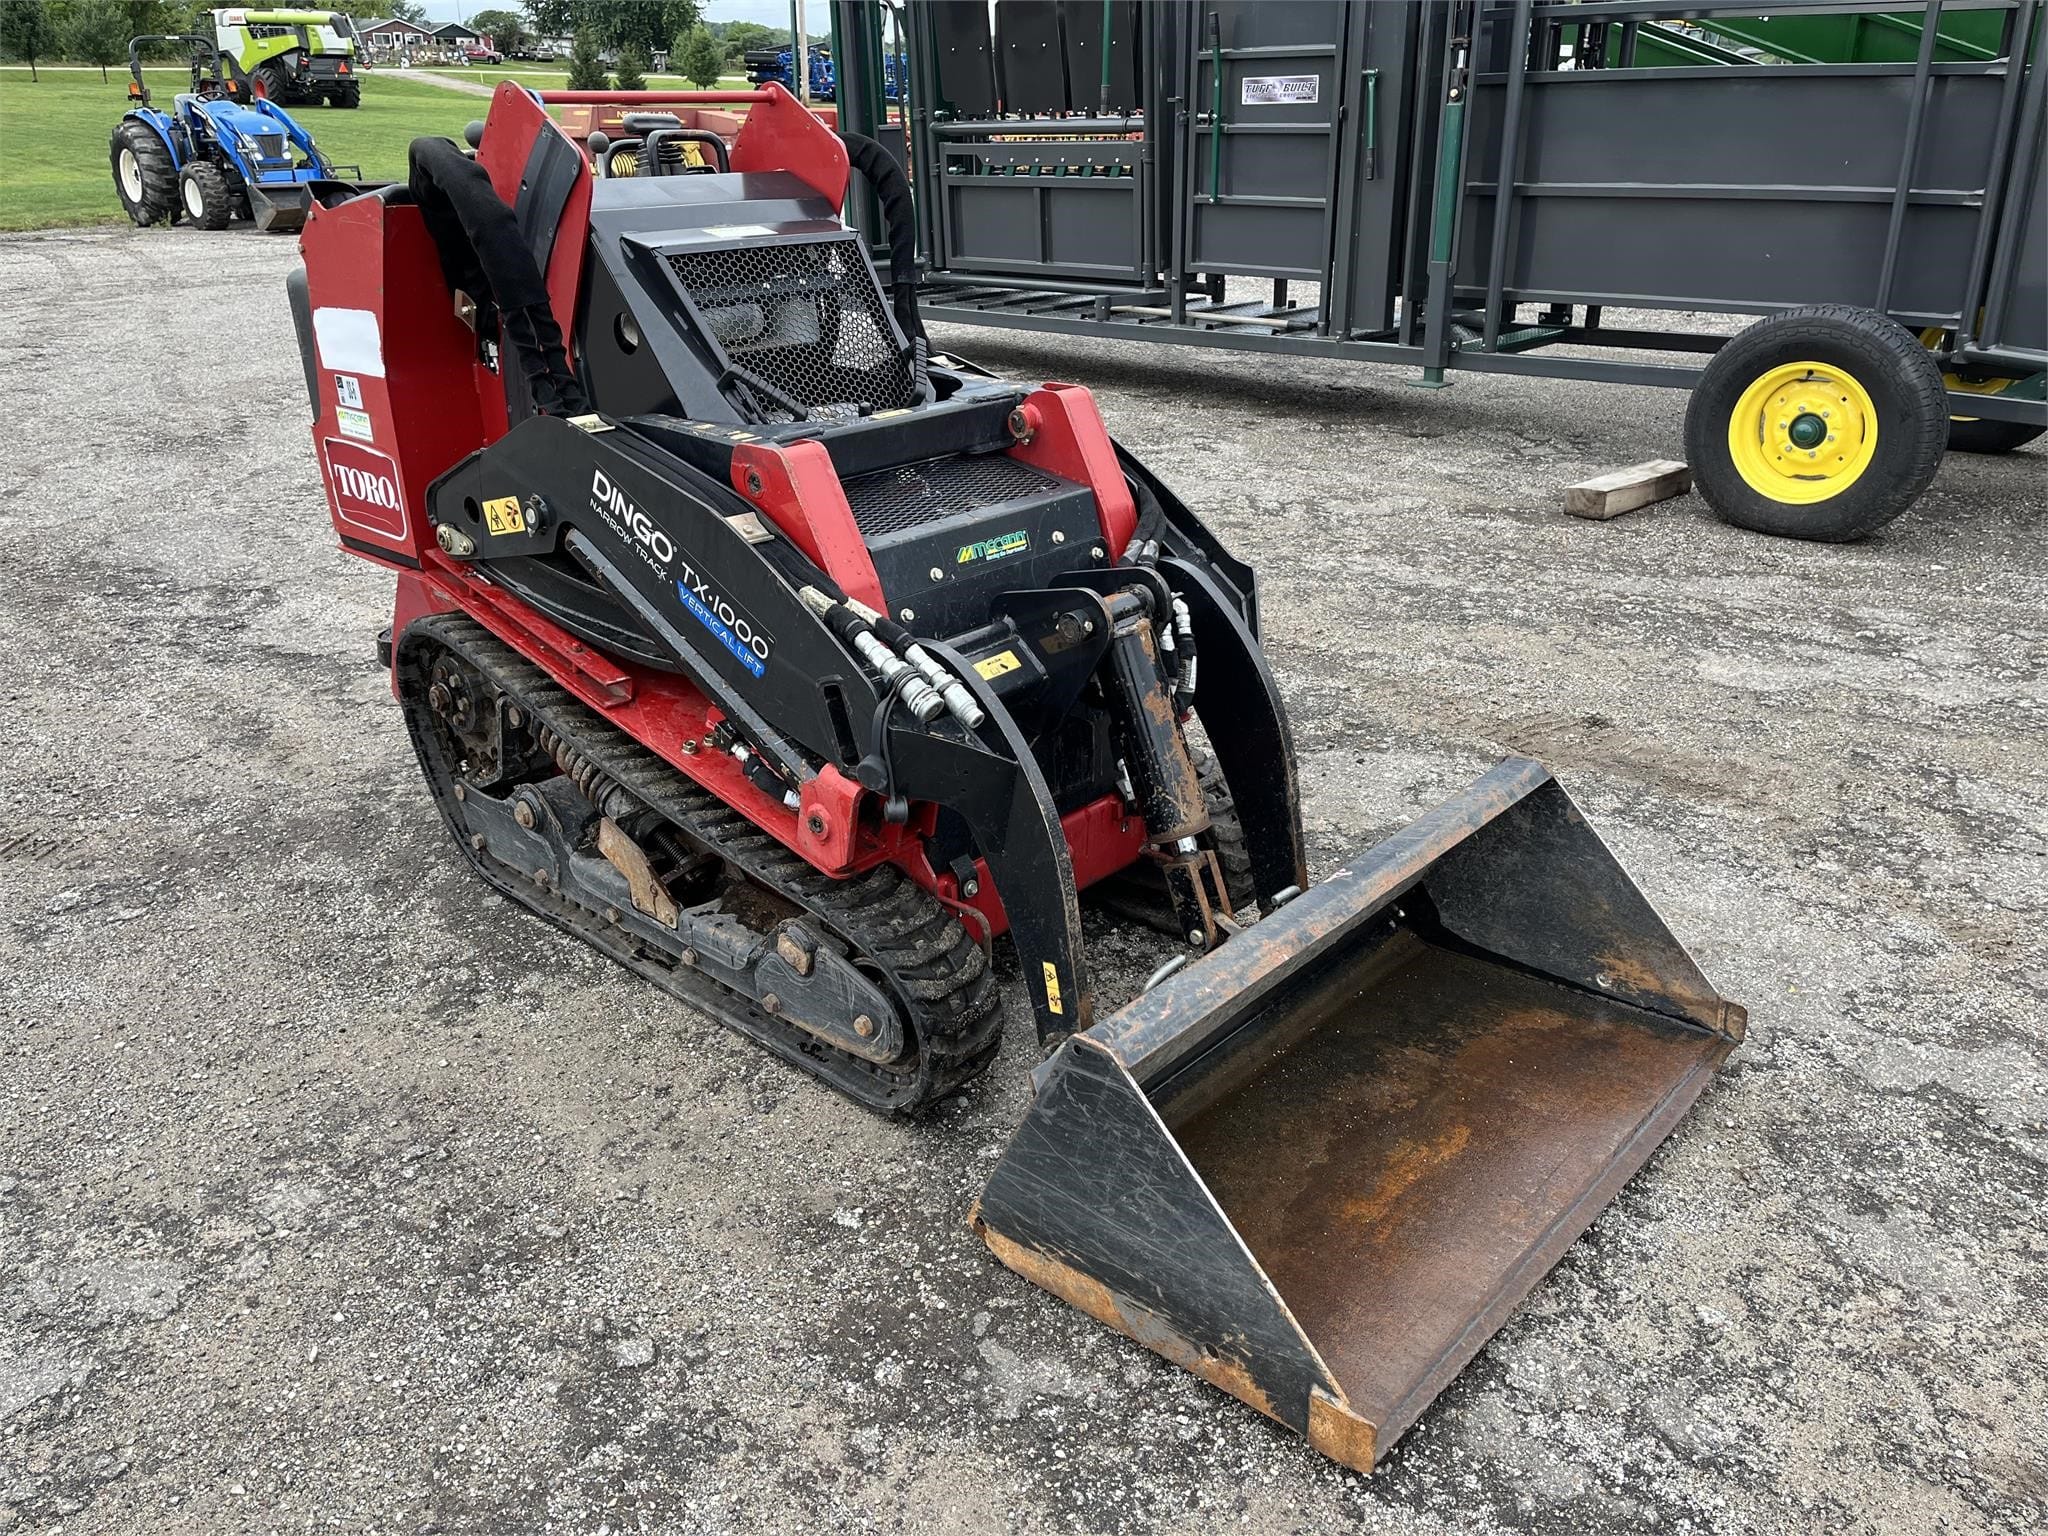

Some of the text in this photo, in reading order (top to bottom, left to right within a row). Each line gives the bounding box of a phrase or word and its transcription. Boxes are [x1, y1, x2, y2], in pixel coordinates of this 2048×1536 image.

[1283, 82, 1315, 92] BUILT
[590, 498, 667, 581] NARROW TRACK
[592, 469, 673, 562] DINGO
[679, 586, 763, 674] VERTICAL LIFT
